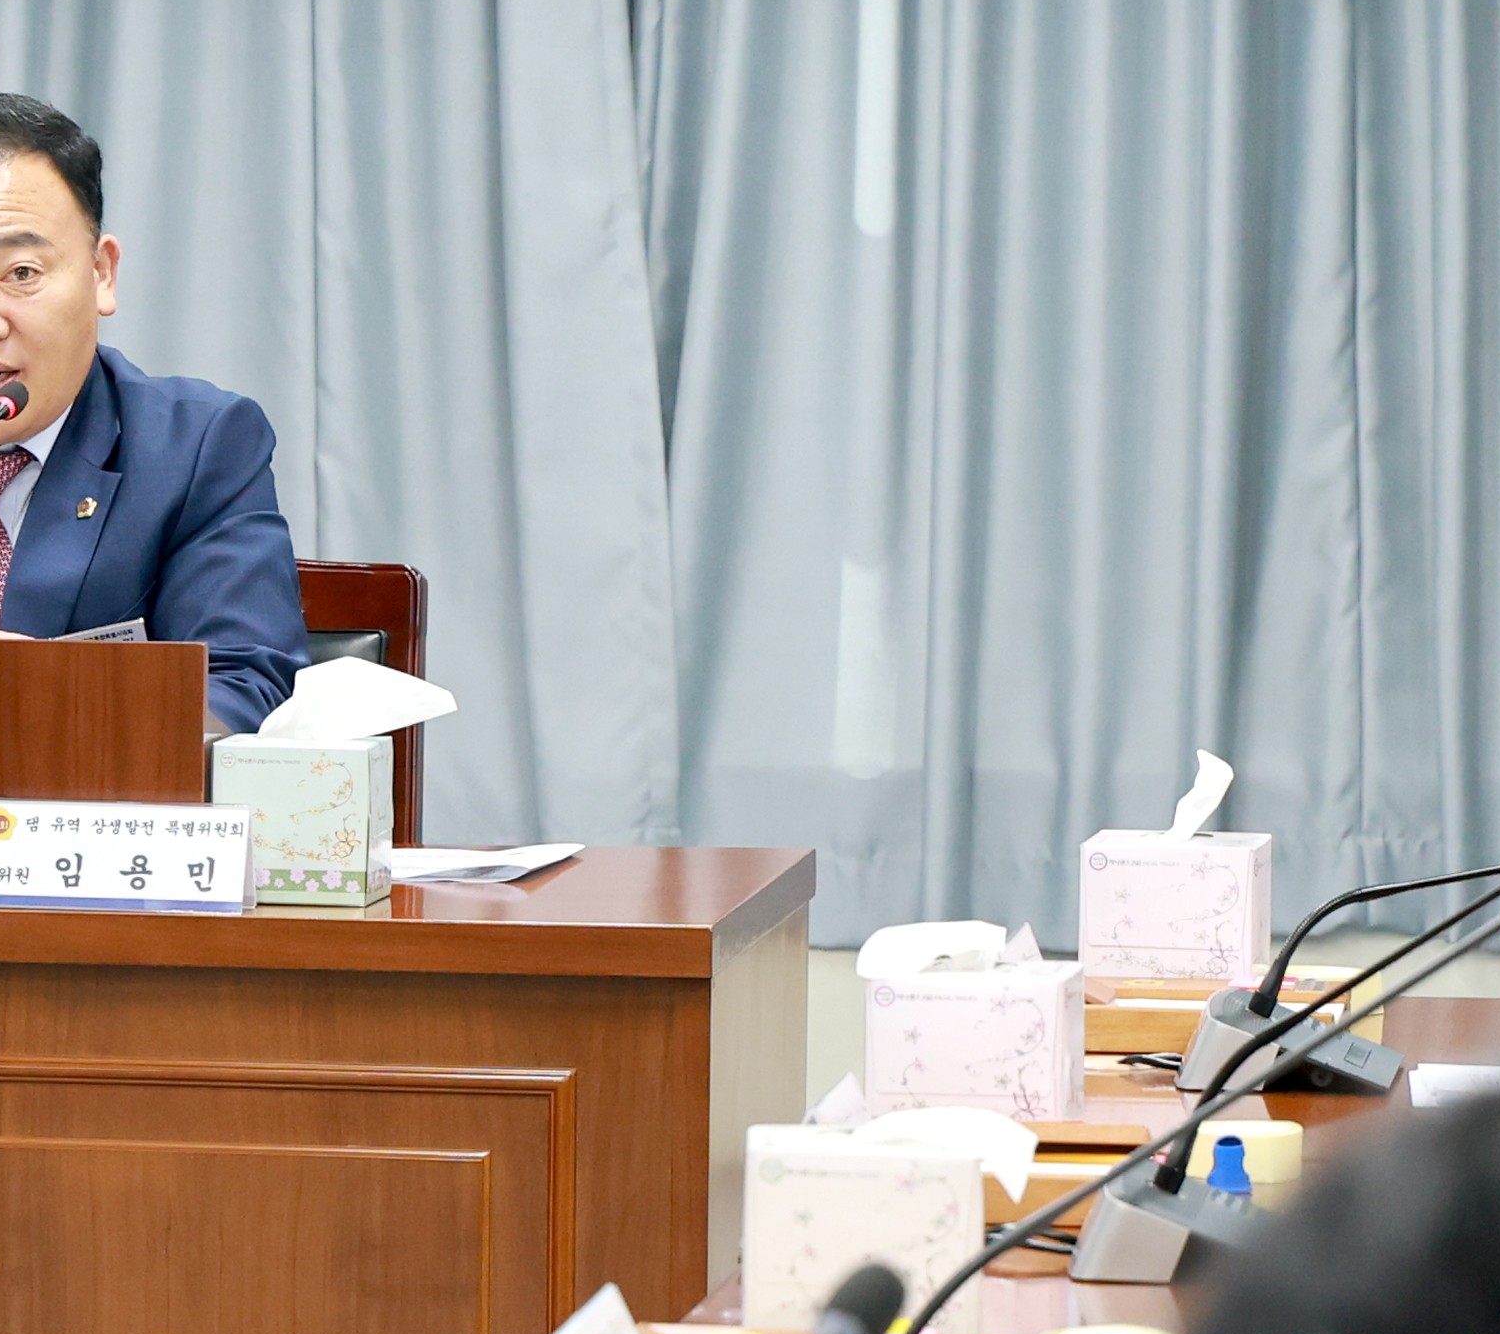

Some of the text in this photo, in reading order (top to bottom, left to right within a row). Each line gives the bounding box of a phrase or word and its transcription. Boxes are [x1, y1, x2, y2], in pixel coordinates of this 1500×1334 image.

[25, 816, 245, 838] 댐 유역 상생발전 특별위원회
[55, 853, 216, 893] 임용민
